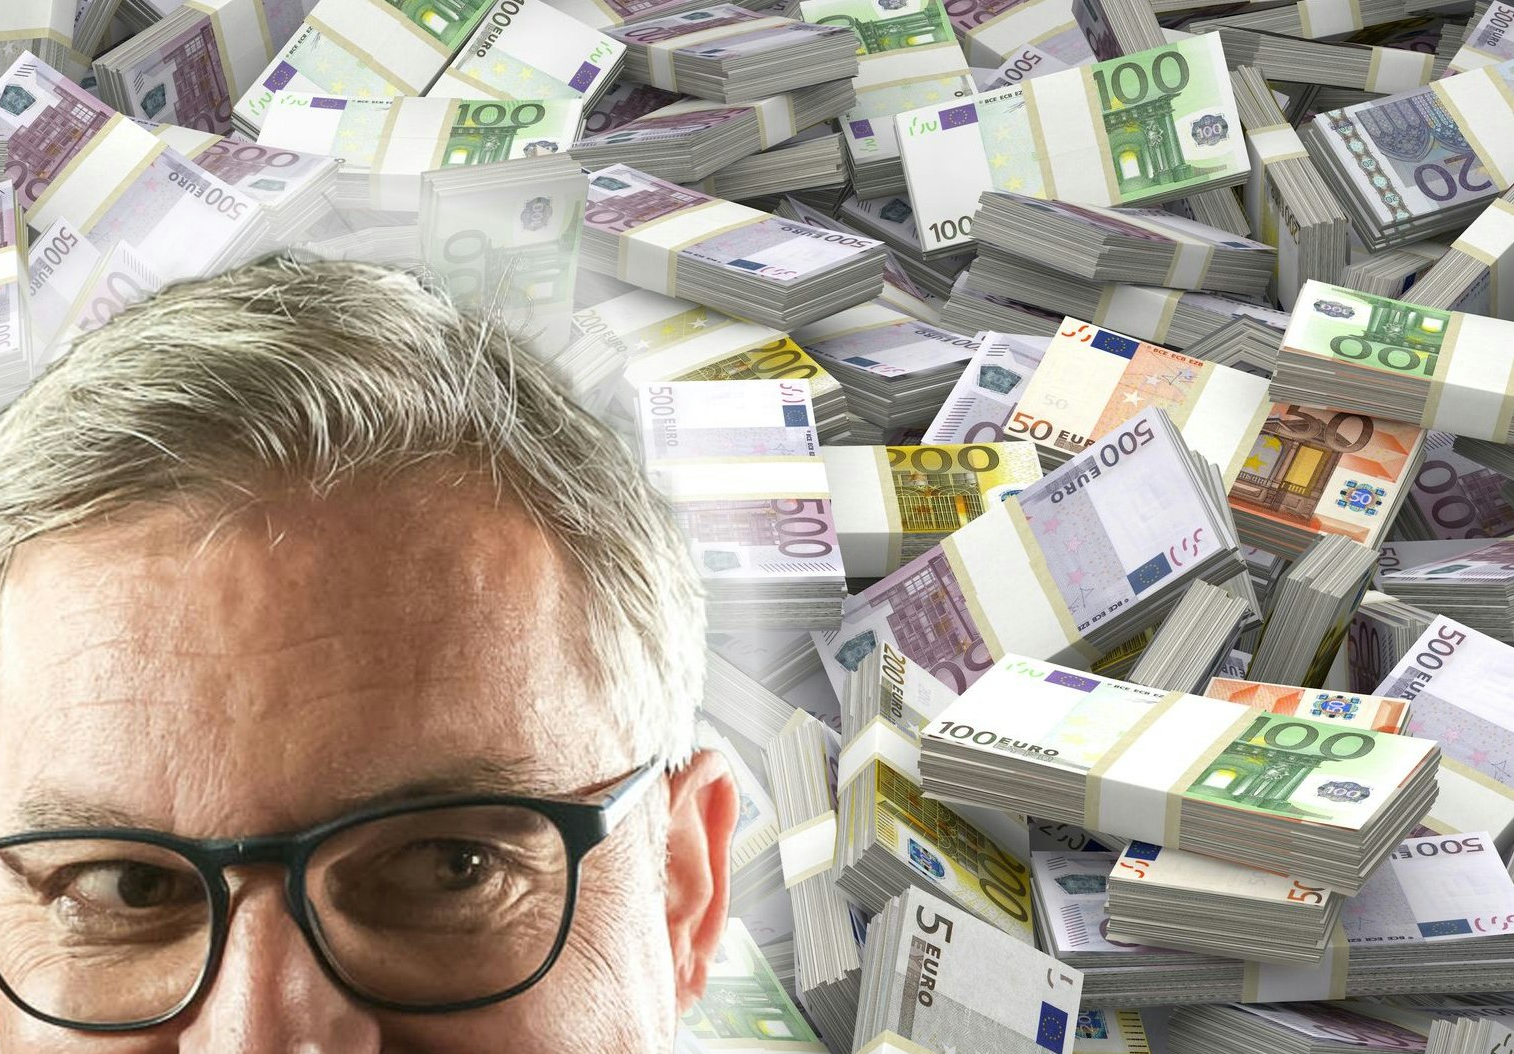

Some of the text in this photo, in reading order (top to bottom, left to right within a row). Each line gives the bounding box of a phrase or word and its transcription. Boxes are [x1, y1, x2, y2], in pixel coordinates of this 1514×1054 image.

[475, 26, 504, 58] EURO
[1487, 29, 1505, 47] EURO
[1005, 51, 1042, 80] 500
[1093, 51, 1190, 103] 100
[456, 103, 546, 128] 100
[1197, 121, 1222, 137] 100
[168, 170, 248, 221] 500 EURO
[1413, 162, 1492, 202] 20
[780, 224, 872, 251] 500 EURO
[30, 226, 78, 297] 500 EURO
[574, 309, 626, 354] 200 EURO
[1330, 335, 1435, 376] 100
[649, 386, 679, 447] 500 EURO
[1007, 412, 1053, 440] 50
[1050, 419, 1155, 504] 500 EURO
[1349, 490, 1372, 504] 50
[771, 498, 834, 558] 500
[1092, 600, 1123, 623] BCE ECB
[1415, 626, 1466, 669] 500
[882, 642, 907, 719] 200 EURO
[1326, 697, 1345, 714] 50
[938, 720, 1060, 758] 100 EURO
[1242, 717, 1376, 761] 100
[1324, 786, 1362, 798] 100
[1414, 837, 1485, 856] 500
[916, 904, 954, 1008] 5 EURO
